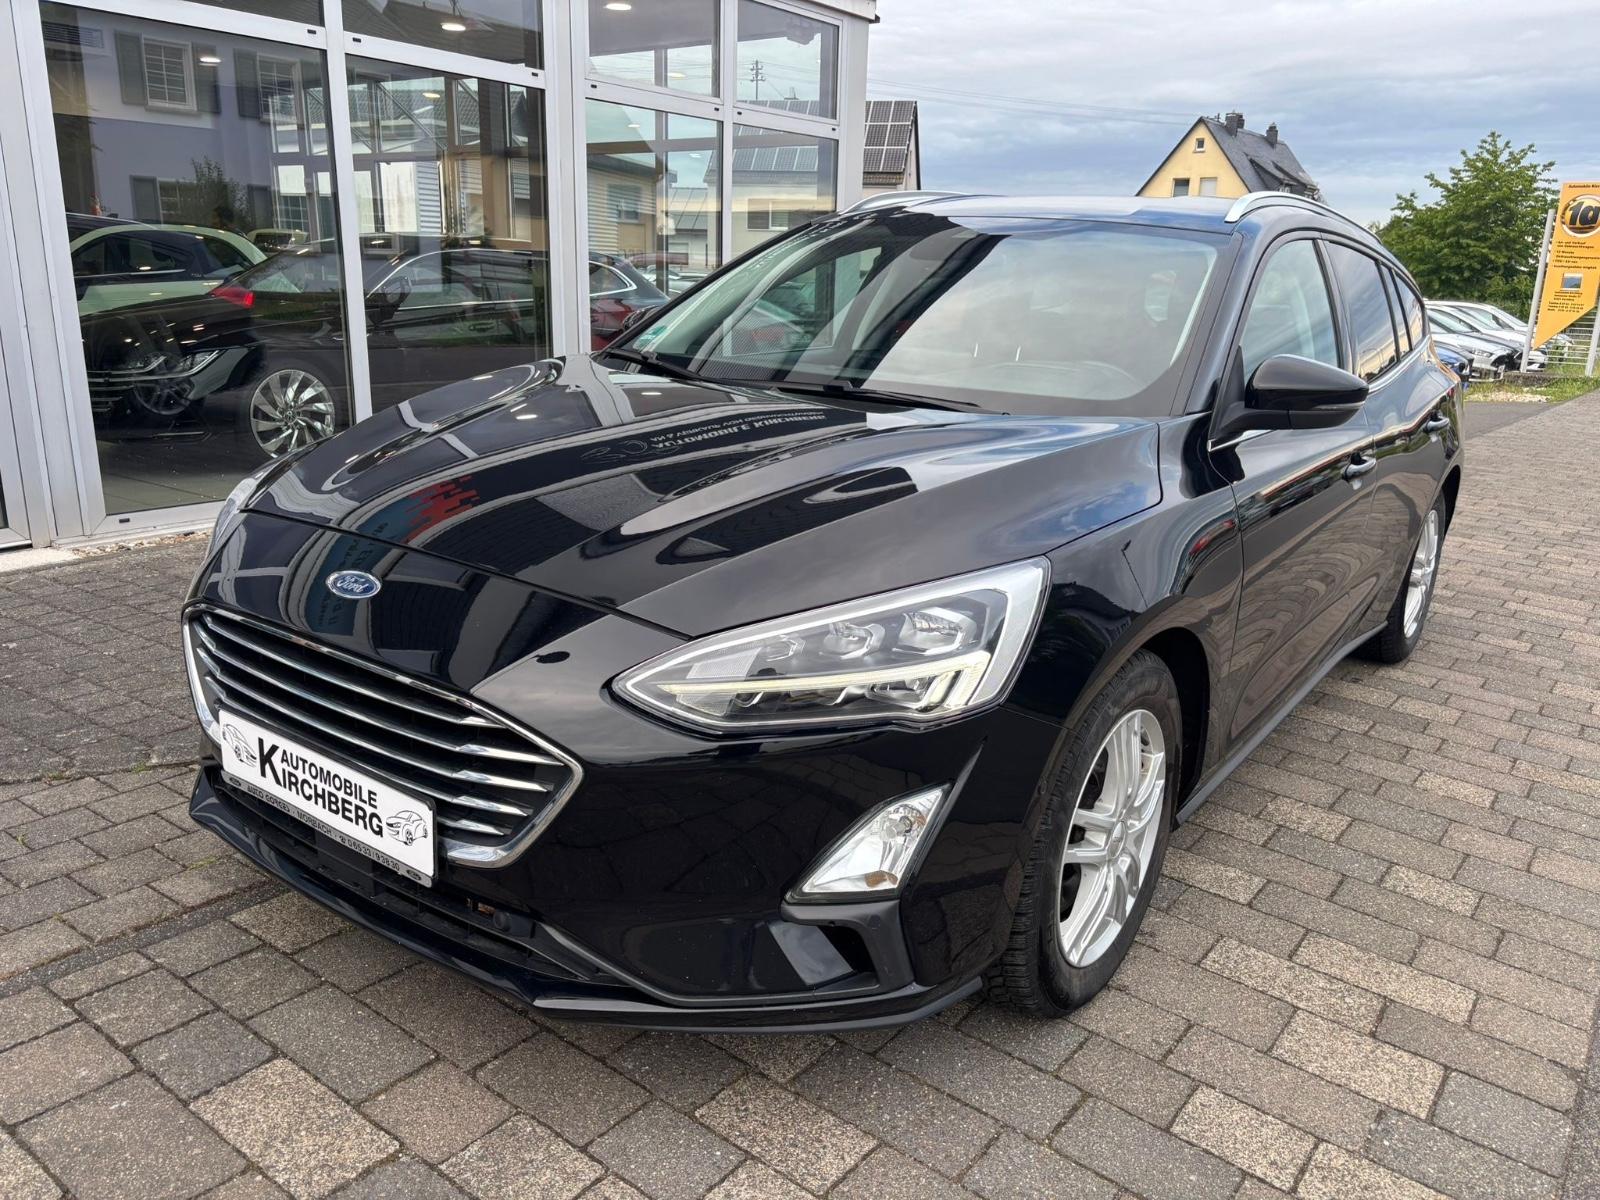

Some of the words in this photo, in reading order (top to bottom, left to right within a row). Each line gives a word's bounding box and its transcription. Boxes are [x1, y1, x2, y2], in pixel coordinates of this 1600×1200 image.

[336, 575, 369, 593] Ford
[257, 737, 384, 838] KIRCHBERG
[280, 749, 378, 810] AUTOMOBILE
[297, 810, 332, 834] MORBACH
